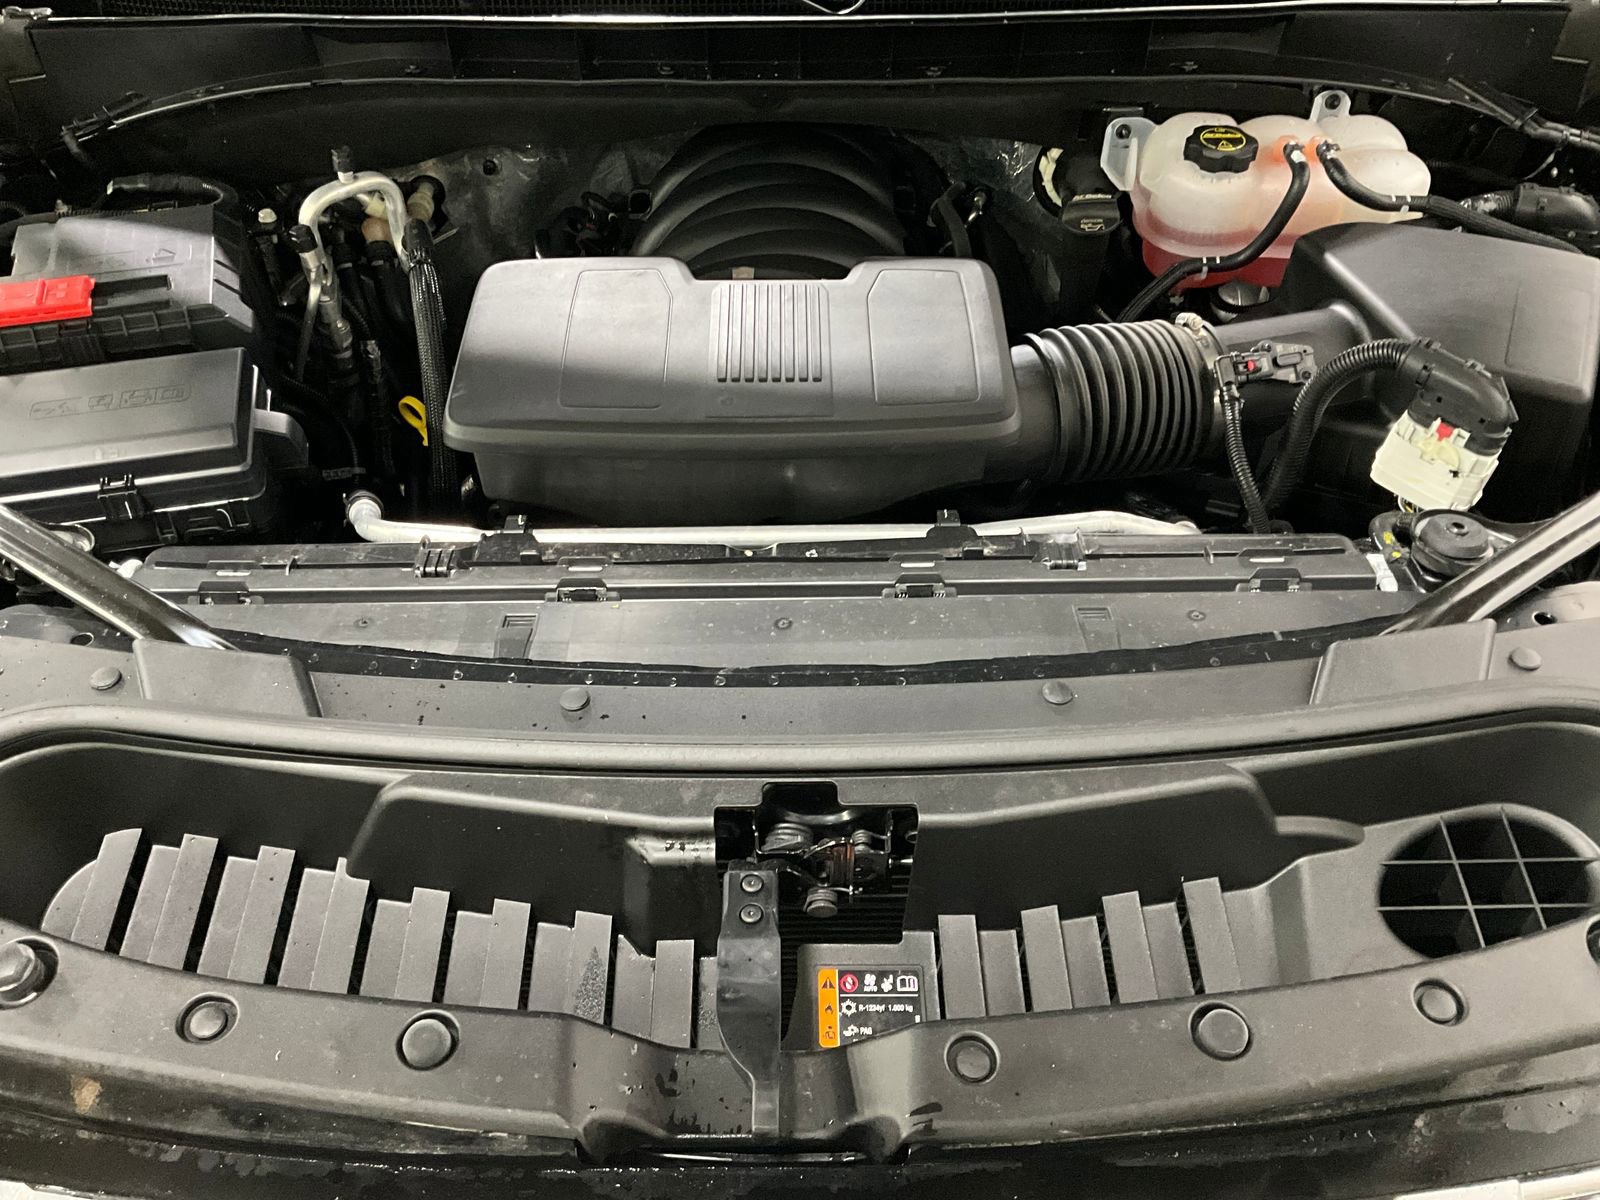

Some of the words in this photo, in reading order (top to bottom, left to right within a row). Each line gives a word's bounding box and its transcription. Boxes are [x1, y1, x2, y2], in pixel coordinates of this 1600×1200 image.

[858, 1004, 885, 1013] R-1234yf
[905, 1004, 913, 1013] kg
[860, 1027, 872, 1035] PAG
